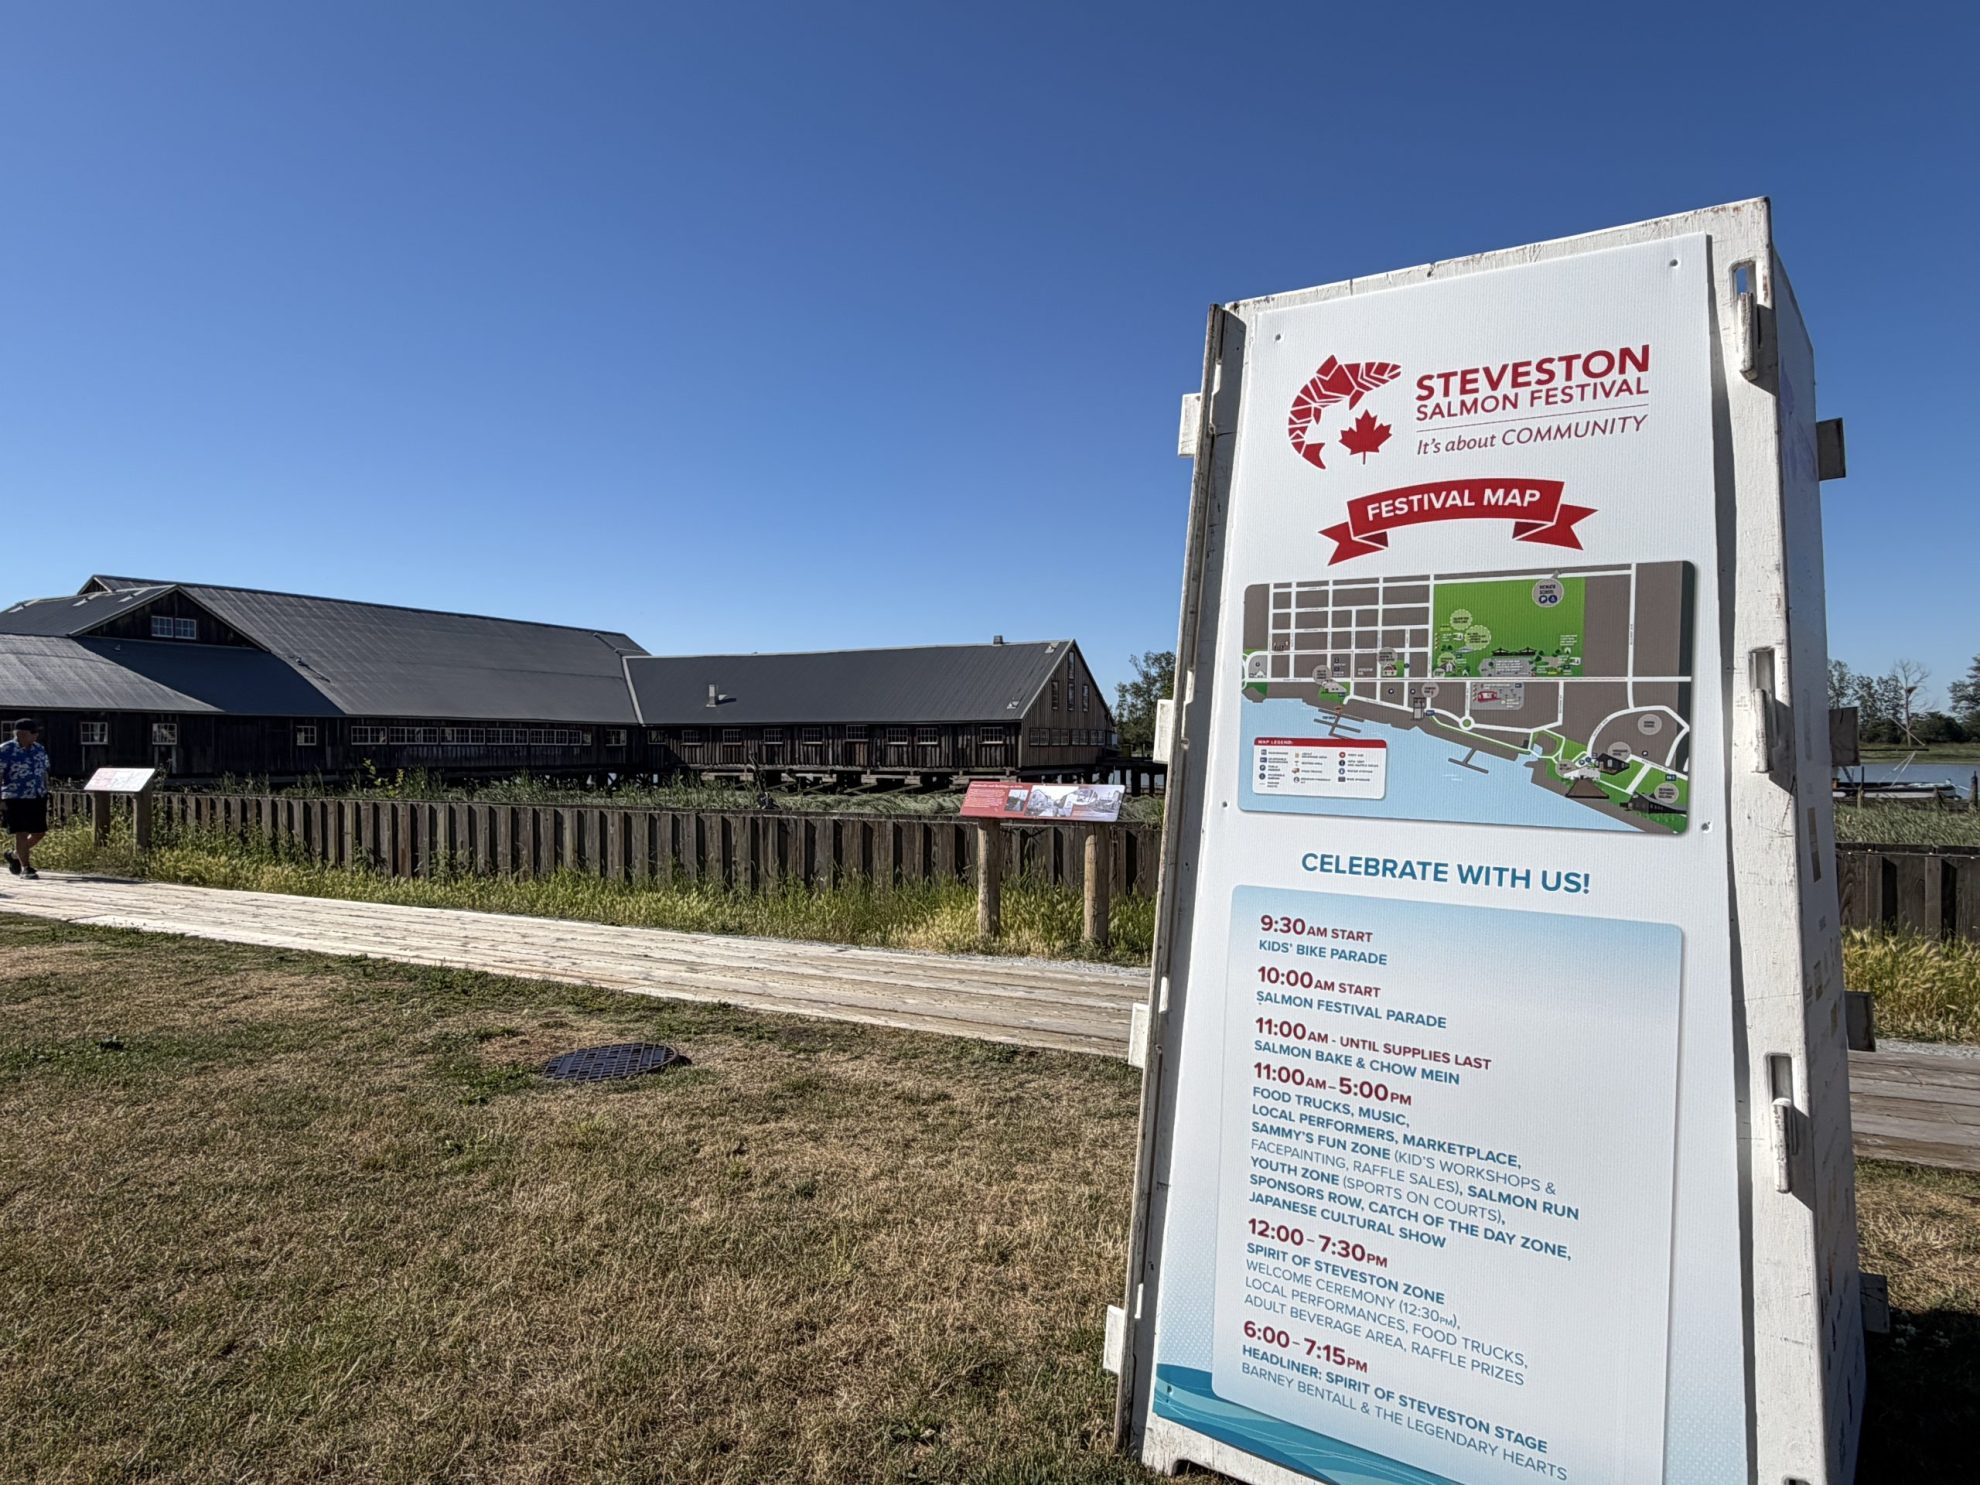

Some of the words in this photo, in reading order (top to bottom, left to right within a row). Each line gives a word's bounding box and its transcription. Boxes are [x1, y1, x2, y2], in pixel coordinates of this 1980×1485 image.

[1415, 344, 1650, 402] STEVESTON
[1416, 392, 1519, 422] SALMON
[1529, 376, 1649, 408] FESTIVAL
[1416, 439, 1441, 456] It's
[1445, 433, 1496, 453] about
[1501, 414, 1648, 447] COMMUNITY
[1366, 489, 1476, 521] FESTIVAL
[1482, 488, 1542, 508] MAP
[1301, 852, 1449, 883] CELEBRATE
[1457, 863, 1531, 889] WITH
[1541, 870, 1591, 894] US!
[1259, 939, 1293, 954] KIDS'
[1296, 943, 1327, 958] BIKE
[1330, 948, 1388, 965] PARADE
[1331, 928, 1374, 943] START
[1256, 990, 1313, 1009] SALMON
[1317, 999, 1382, 1019] FESTIVAL
[1386, 1009, 1447, 1028] PARADE
[1338, 982, 1381, 998] START
[1254, 1040, 1311, 1059] SALMON
[1315, 1050, 1353, 1067] BAKE
[1356, 1057, 1366, 1069] &
[1369, 1059, 1417, 1077] CHOW
[1421, 1068, 1460, 1085] MEIN
[1340, 1036, 1380, 1052] UNTIL
[1383, 1043, 1451, 1064] SUPPLIES
[1454, 1054, 1492, 1070] LAST
[1253, 1086, 1291, 1103] FOOD
[1295, 1094, 1354, 1118] TRUCKS,
[1358, 1106, 1410, 1128] MUSIC,
[1251, 1121, 1314, 1144] SAMMY'S
[1317, 1134, 1347, 1150] FUN
[1350, 1141, 1391, 1160] ZONE
[1394, 1149, 1435, 1169] (KID'S
[1439, 1159, 1541, 1192] WORKSHOPS
[1545, 1182, 1556, 1195] &
[1252, 1103, 1295, 1122] LOCAL
[1299, 1113, 1398, 1145] PERFORMERS,
[1403, 1133, 1521, 1169] MARKETPLACE,
[1250, 1156, 1297, 1176] YOUTH
[1301, 1167, 1340, 1186] ZONE
[1343, 1175, 1402, 1200] (SPORTS
[1406, 1190, 1429, 1206] ON
[1434, 1197, 1505, 1225] COURTS),
[1251, 1138, 1349, 1171] FACEPAINTING,
[1353, 1160, 1405, 1182] RAFFLE
[1409, 1172, 1463, 1196] SALES),
[1467, 1185, 1537, 1211] SALMON
[1542, 1201, 1579, 1220] RUN
[1249, 1174, 1324, 1200] SPONSORS
[1328, 1191, 1364, 1211] ROW,
[1368, 1201, 1418, 1223] CATCH
[1423, 1214, 1445, 1228] OF
[1448, 1219, 1479, 1237] THE
[1484, 1228, 1516, 1245] DAY
[1521, 1236, 1571, 1261] ZONE,
[1249, 1191, 1317, 1217] JAPANESE
[1320, 1208, 1395, 1236] CULTURAL
[1399, 1227, 1446, 1248] SHOW
[1246, 1258, 1312, 1287] WELCOME
[1316, 1278, 1395, 1309] CEREMONY
[1247, 1242, 1288, 1262] SPIRIT
[1291, 1254, 1311, 1268] OF
[1314, 1259, 1399, 1292] STEVESTON
[1403, 1282, 1445, 1305] ZONE
[1244, 1293, 1287, 1314] ADULT
[1290, 1307, 1362, 1337] BEVERAGE
[1365, 1328, 1407, 1352] AREA,
[1411, 1341, 1466, 1369] RAFFLE
[1471, 1359, 1524, 1386] PRIZES
[1245, 1276, 1287, 1298] LOCAL
[1291, 1288, 1408, 1334] PERFORMANCES,
[1413, 1323, 1457, 1346] FOOD
[1461, 1336, 1528, 1369] TRUCKS,
[1242, 1344, 1322, 1380] HEADLINER:
[1325, 1371, 1370, 1394] SPIRIT
[1374, 1386, 1395, 1401] OF
[1398, 1394, 1490, 1434] STEVESTON
[1494, 1426, 1548, 1453] STAGE
[1242, 1362, 1294, 1387] BARNEY
[1297, 1380, 1356, 1410] BENTALL
[1360, 1402, 1370, 1415] &
[1375, 1405, 1402, 1425] THE
[1407, 1416, 1498, 1456] LEGENDARY
[1503, 1448, 1567, 1481] HEARTS
